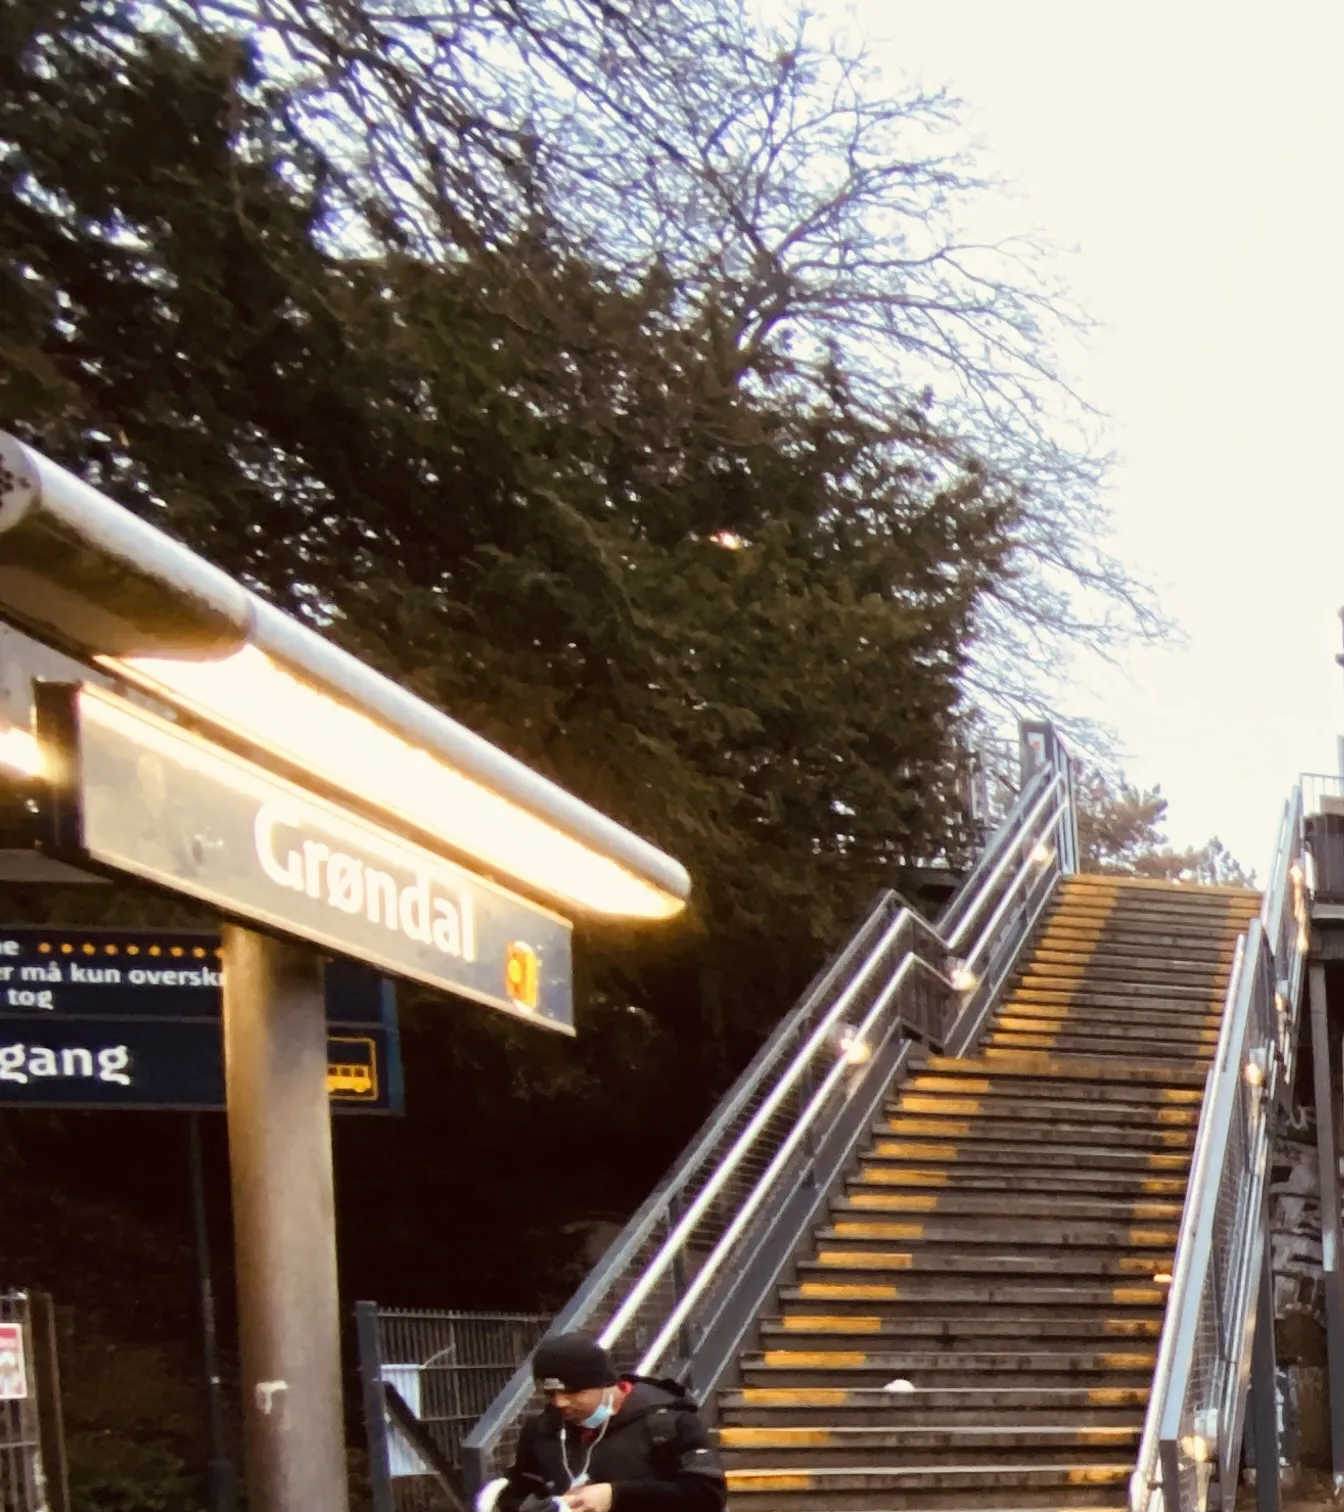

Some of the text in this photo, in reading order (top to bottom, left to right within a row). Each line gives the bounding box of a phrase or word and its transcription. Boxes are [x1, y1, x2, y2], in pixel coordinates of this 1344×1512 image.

[254, 798, 476, 963] Grøndal
[21, 960, 62, 982] må
[70, 962, 121, 983] kun
[8, 988, 54, 1010] tog
